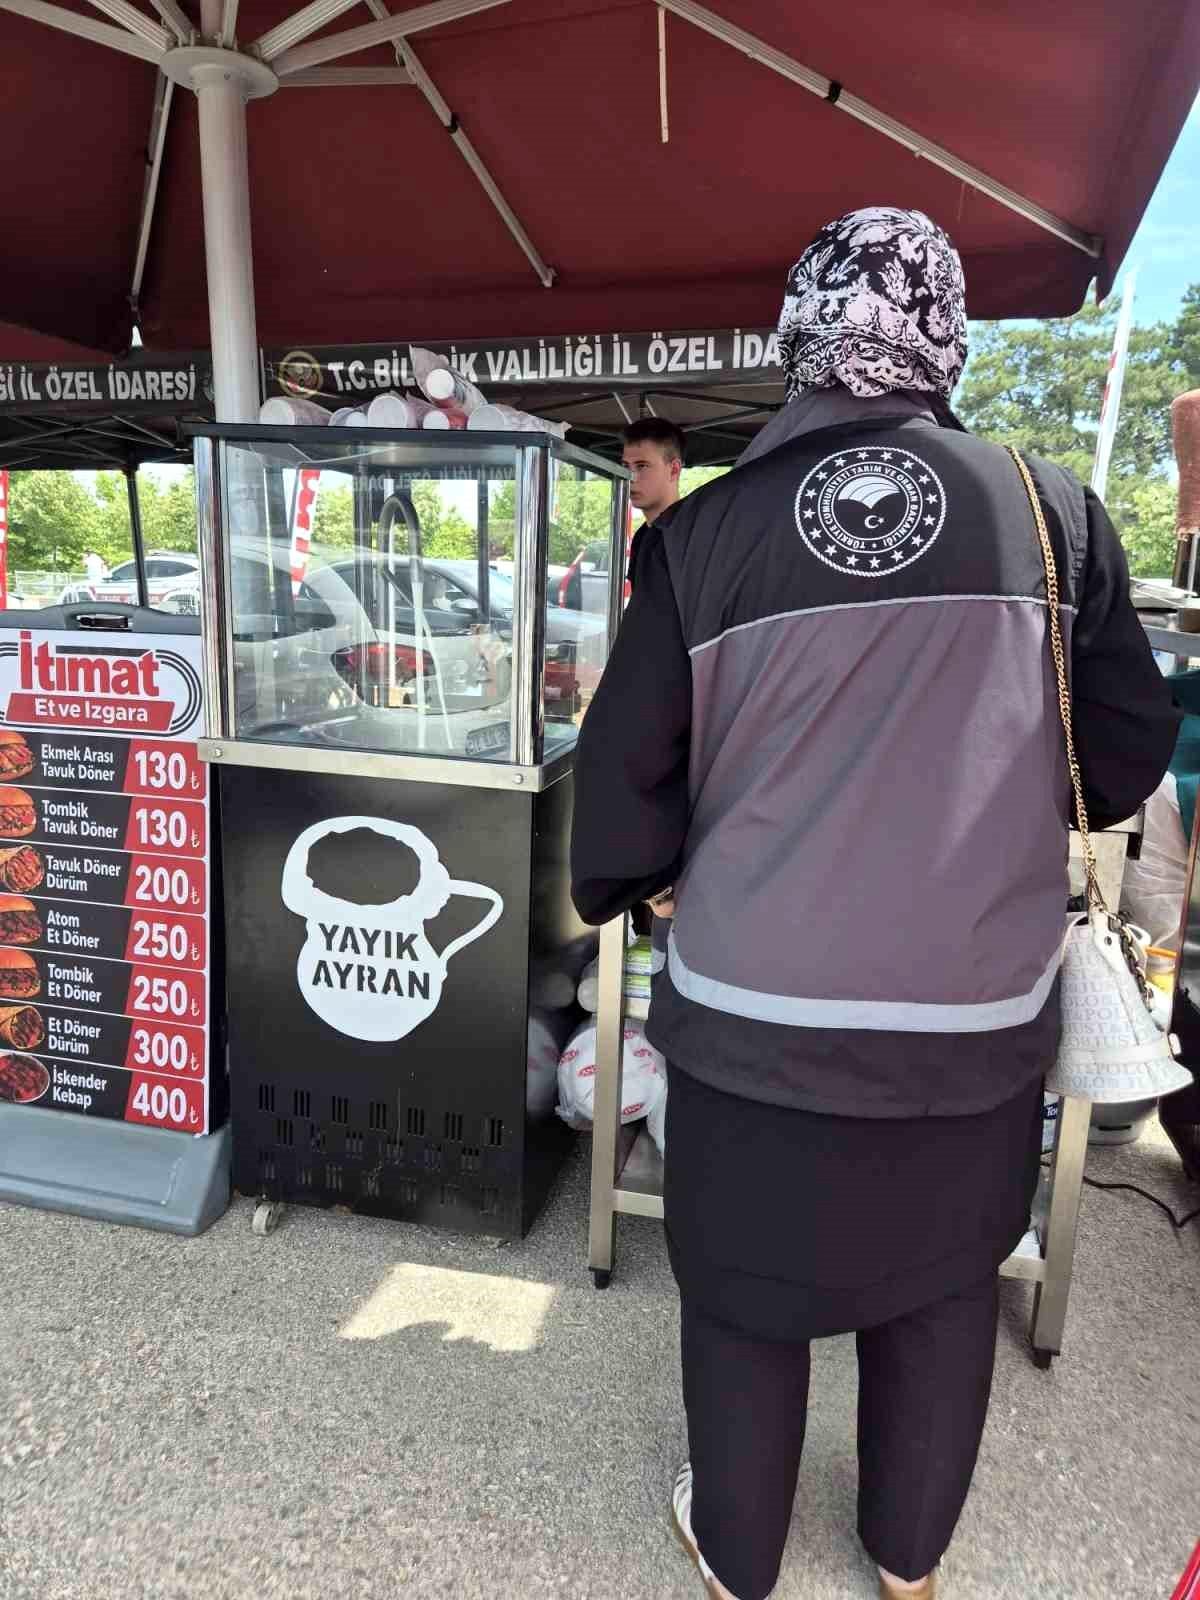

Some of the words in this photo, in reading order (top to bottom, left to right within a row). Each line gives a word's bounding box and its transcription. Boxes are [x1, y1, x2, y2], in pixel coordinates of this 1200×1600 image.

[486, 335, 602, 382] VALİLİĞİ
[613, 334, 639, 375] İL
[648, 332, 723, 373] ÖZEL
[732, 328, 783, 369] İDA
[20, 366, 42, 400] İL
[45, 366, 103, 400] ÖZEL
[108, 364, 196, 400] İDARESİ
[852, 465, 882, 475] TARIM
[884, 467, 897, 477] VE
[896, 474, 918, 502] ORMAN
[34, 697, 56, 717] Et
[58, 703, 81, 718] ve
[85, 701, 149, 722] Izgara
[41, 744, 81, 762] Ekmek
[84, 747, 114, 764] Arası
[42, 763, 75, 778] Tavuk
[78, 764, 115, 781] Döner
[42, 799, 89, 818] Tombik
[42, 817, 78, 835] Tavuk
[80, 821, 118, 839] Döner
[46, 855, 81, 874] Tavuk
[84, 858, 121, 877] Döner
[47, 872, 88, 892] Dürüm
[47, 910, 80, 928] Atom
[47, 928, 61, 945] Et
[63, 930, 100, 949] Döner
[318, 923, 420, 962] YAYIK
[48, 963, 94, 984] Tombik
[312, 959, 430, 1001] AYRAN
[48, 981, 61, 999] Et
[63, 984, 102, 1003] Döner
[48, 1017, 61, 1034] Et
[63, 1019, 101, 1039] Döner
[48, 1036, 90, 1055] Dürüm
[53, 1065, 107, 1092] İskender
[53, 1085, 93, 1110] Kebap
